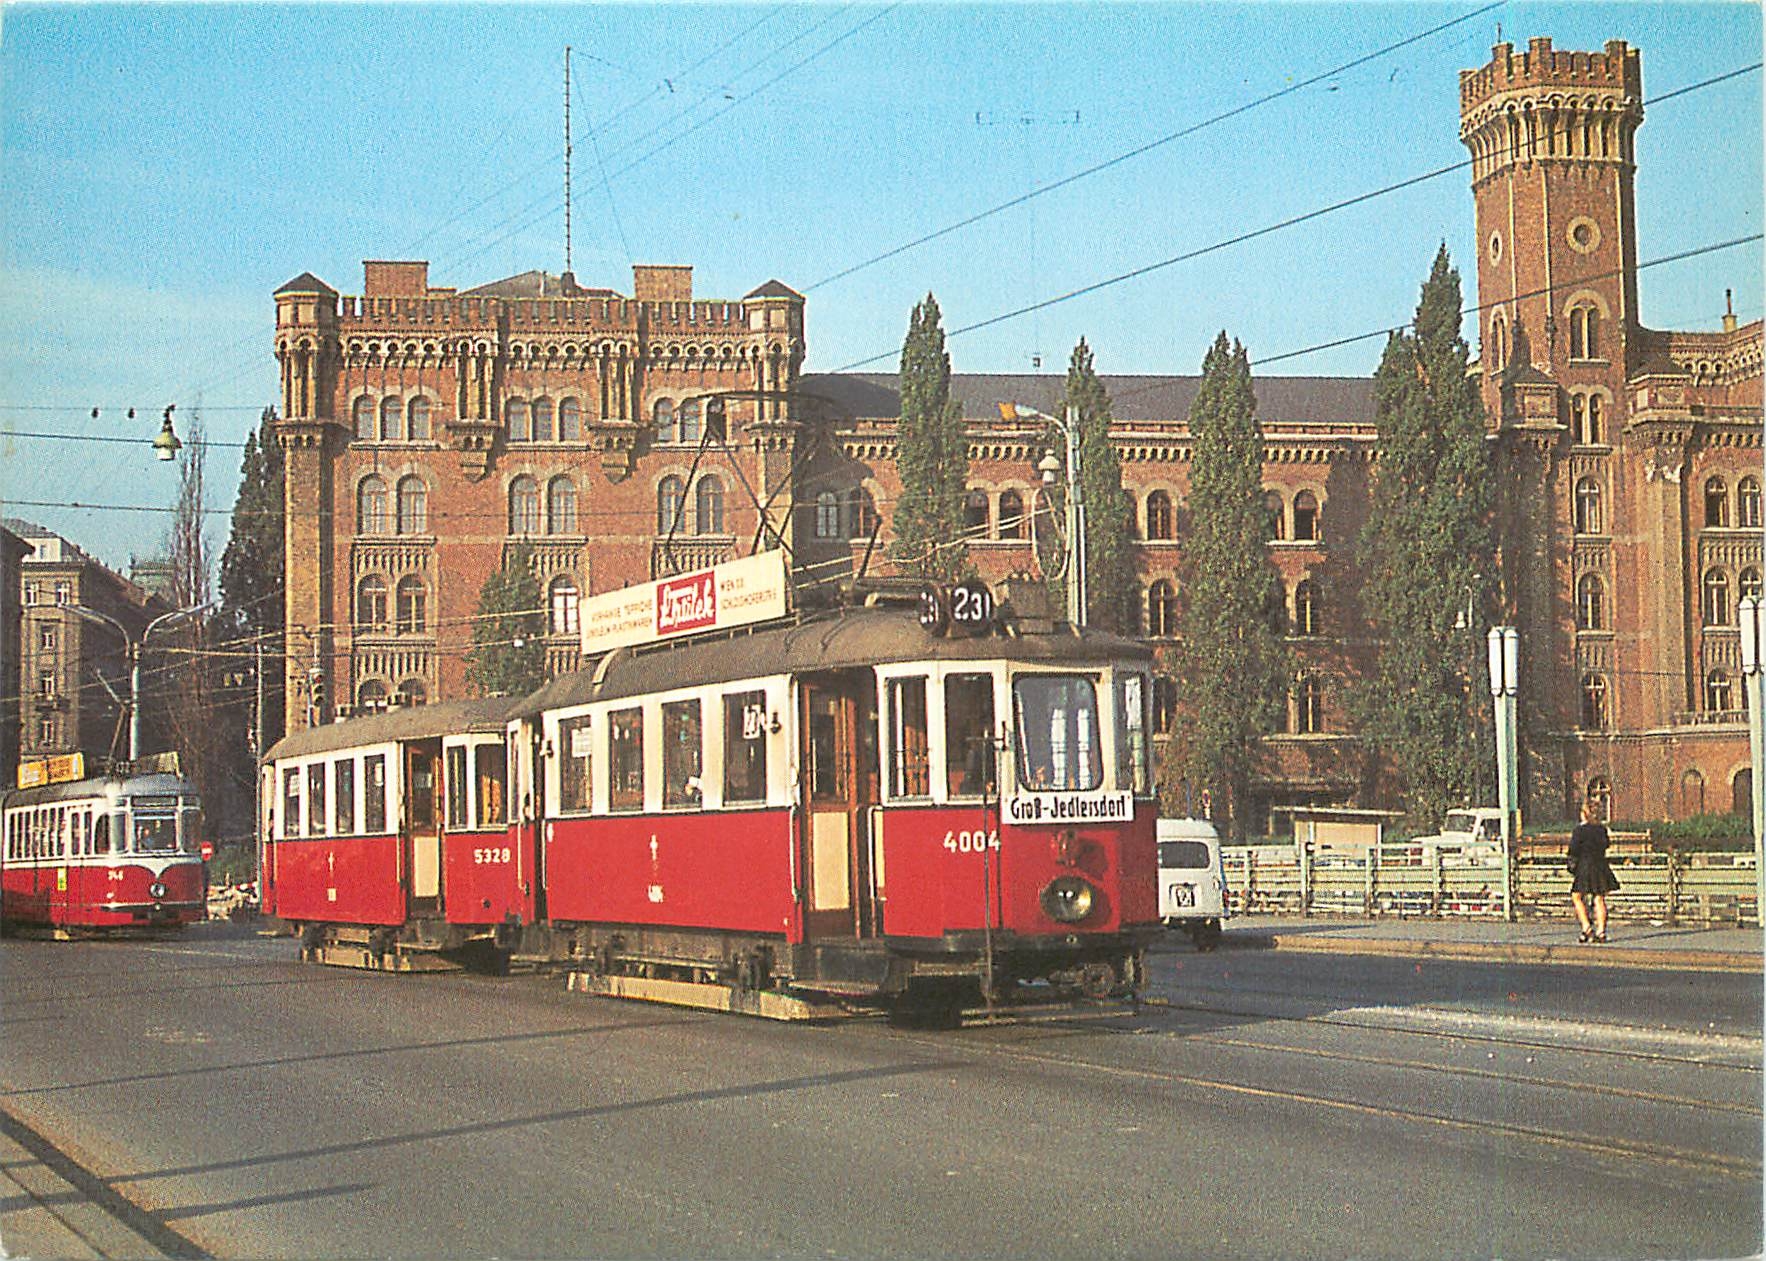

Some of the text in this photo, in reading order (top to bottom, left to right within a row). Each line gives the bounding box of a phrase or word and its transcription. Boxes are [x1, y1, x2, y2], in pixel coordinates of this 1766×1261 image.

[954, 587, 991, 620] 231
[1010, 794, 1126, 821] Groß-Jedlersdorf
[943, 830, 1001, 853] 4004
[473, 847, 511, 865] 5328
